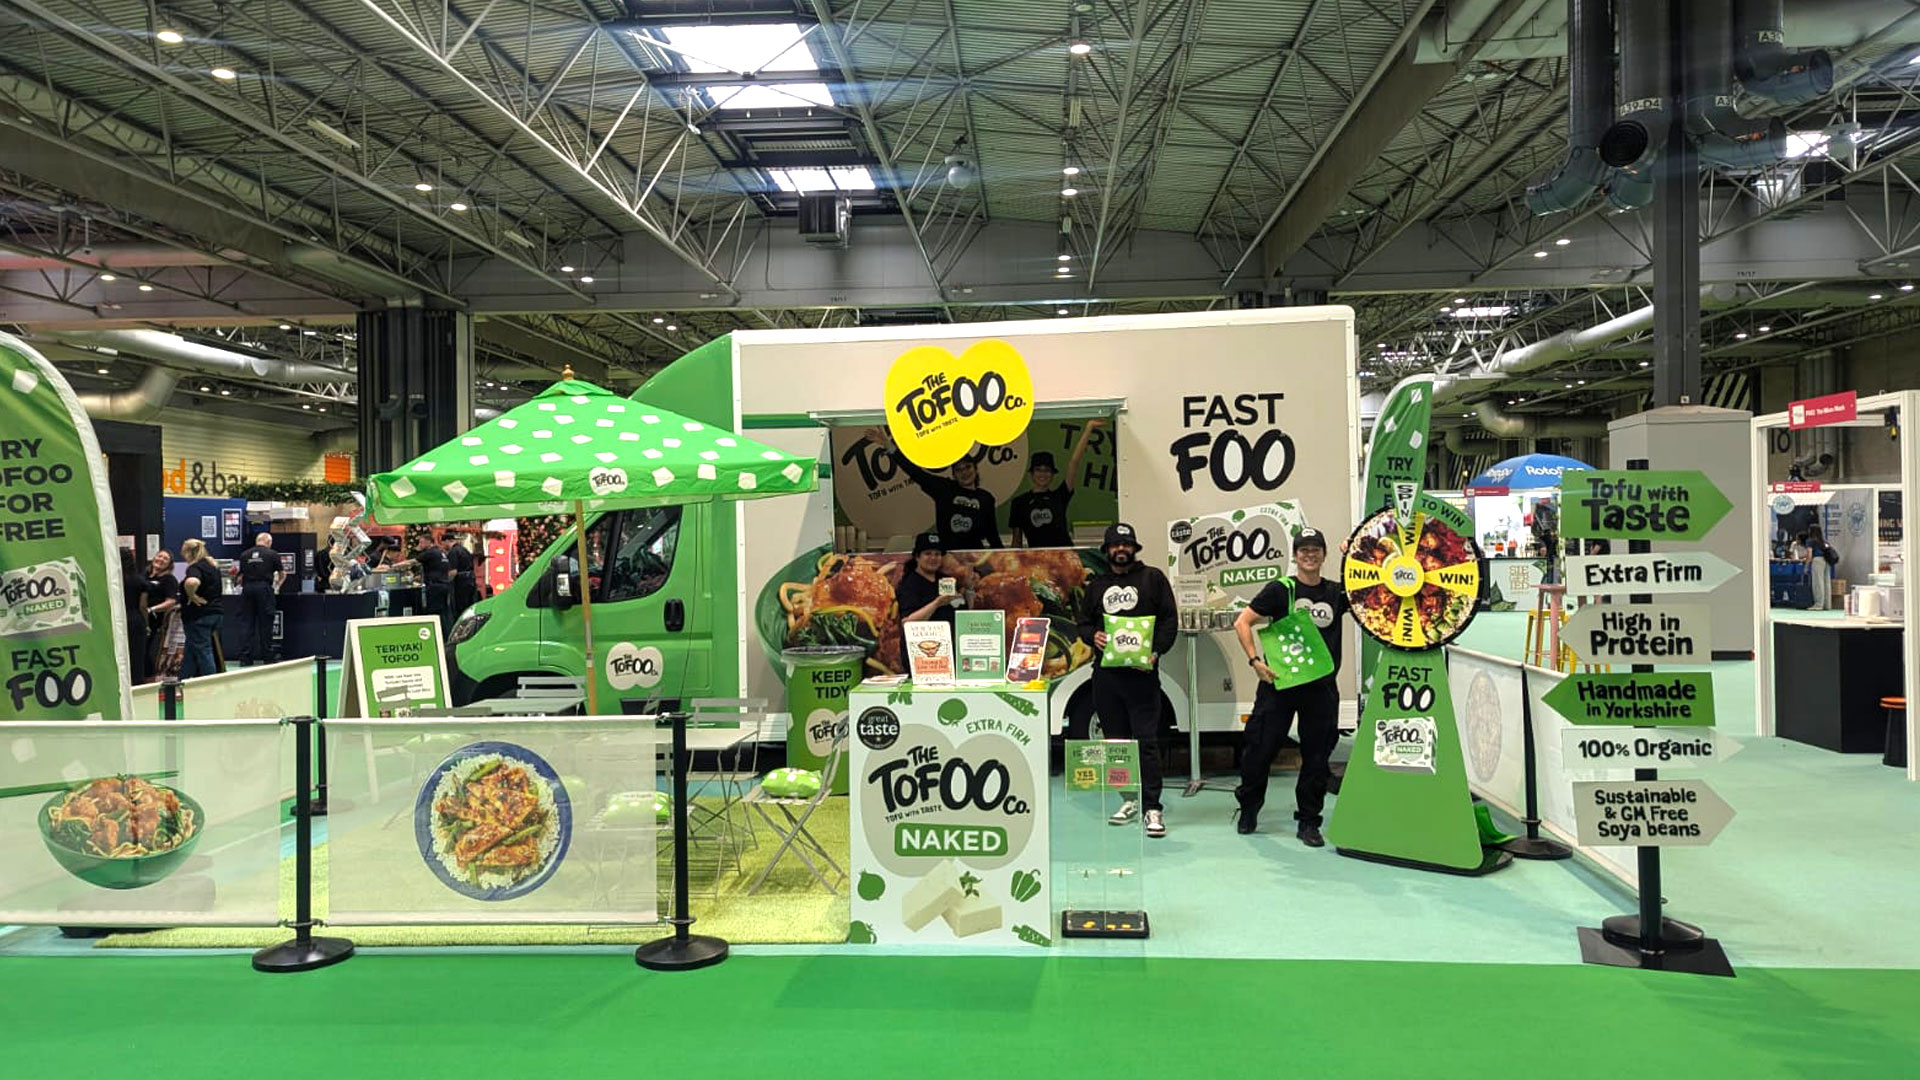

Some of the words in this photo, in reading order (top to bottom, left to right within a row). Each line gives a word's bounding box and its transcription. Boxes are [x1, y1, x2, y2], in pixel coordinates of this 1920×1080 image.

[922, 372, 947, 391] THE
[1183, 393, 1284, 428] FAST
[0, 439, 42, 460] RY
[1170, 429, 1296, 492] FOO
[1387, 457, 1413, 471] TRY
[0, 464, 73, 487] FOO
[191, 462, 208, 495] &
[1587, 478, 1642, 501] Tofu
[1648, 485, 1689, 502] with
[1397, 485, 1413, 517] SPIN
[1422, 499, 1437, 510] TO
[1440, 506, 1465, 527] WIN
[1582, 499, 1690, 532] Taste
[1207, 526, 1226, 540] THE
[1223, 567, 1278, 584] NAKED
[1349, 569, 1380, 580] WIN!
[1439, 573, 1473, 585] WIN!
[1585, 564, 1648, 586] Extra
[1653, 560, 1702, 583] Firm
[25, 600, 64, 613] NAKED
[1402, 608, 1413, 642] WIN!
[1602, 612, 1651, 635] High
[1660, 613, 1680, 631] in
[375, 642, 423, 654] TERIYAKI
[1590, 630, 1693, 656] Protein
[11, 645, 80, 671] FAST
[381, 653, 419, 664] TOFOO
[812, 669, 852, 683] KEEP
[1388, 666, 1432, 682] FAST
[6, 668, 92, 711] FOO
[814, 685, 850, 699] TIDY
[1382, 684, 1435, 712] FOO
[1577, 680, 1696, 701] Handmade
[1587, 703, 1601, 716] in
[1604, 702, 1692, 719] Yorkshire
[860, 723, 898, 736] taste
[966, 719, 1002, 734] EXTRA
[1006, 723, 1031, 746] FIRM
[907, 746, 938, 766] THE
[1578, 740, 1630, 758] 100%
[1634, 738, 1712, 760] Organic
[1003, 796, 1030, 815] Co.
[1595, 788, 1697, 804] Sustainable
[1605, 807, 1617, 819] &
[1621, 806, 1646, 820] GM
[1650, 806, 1688, 821] Free
[902, 829, 1001, 851] NAKED
[1598, 821, 1641, 841] Soya
[1647, 821, 1701, 837] beans
